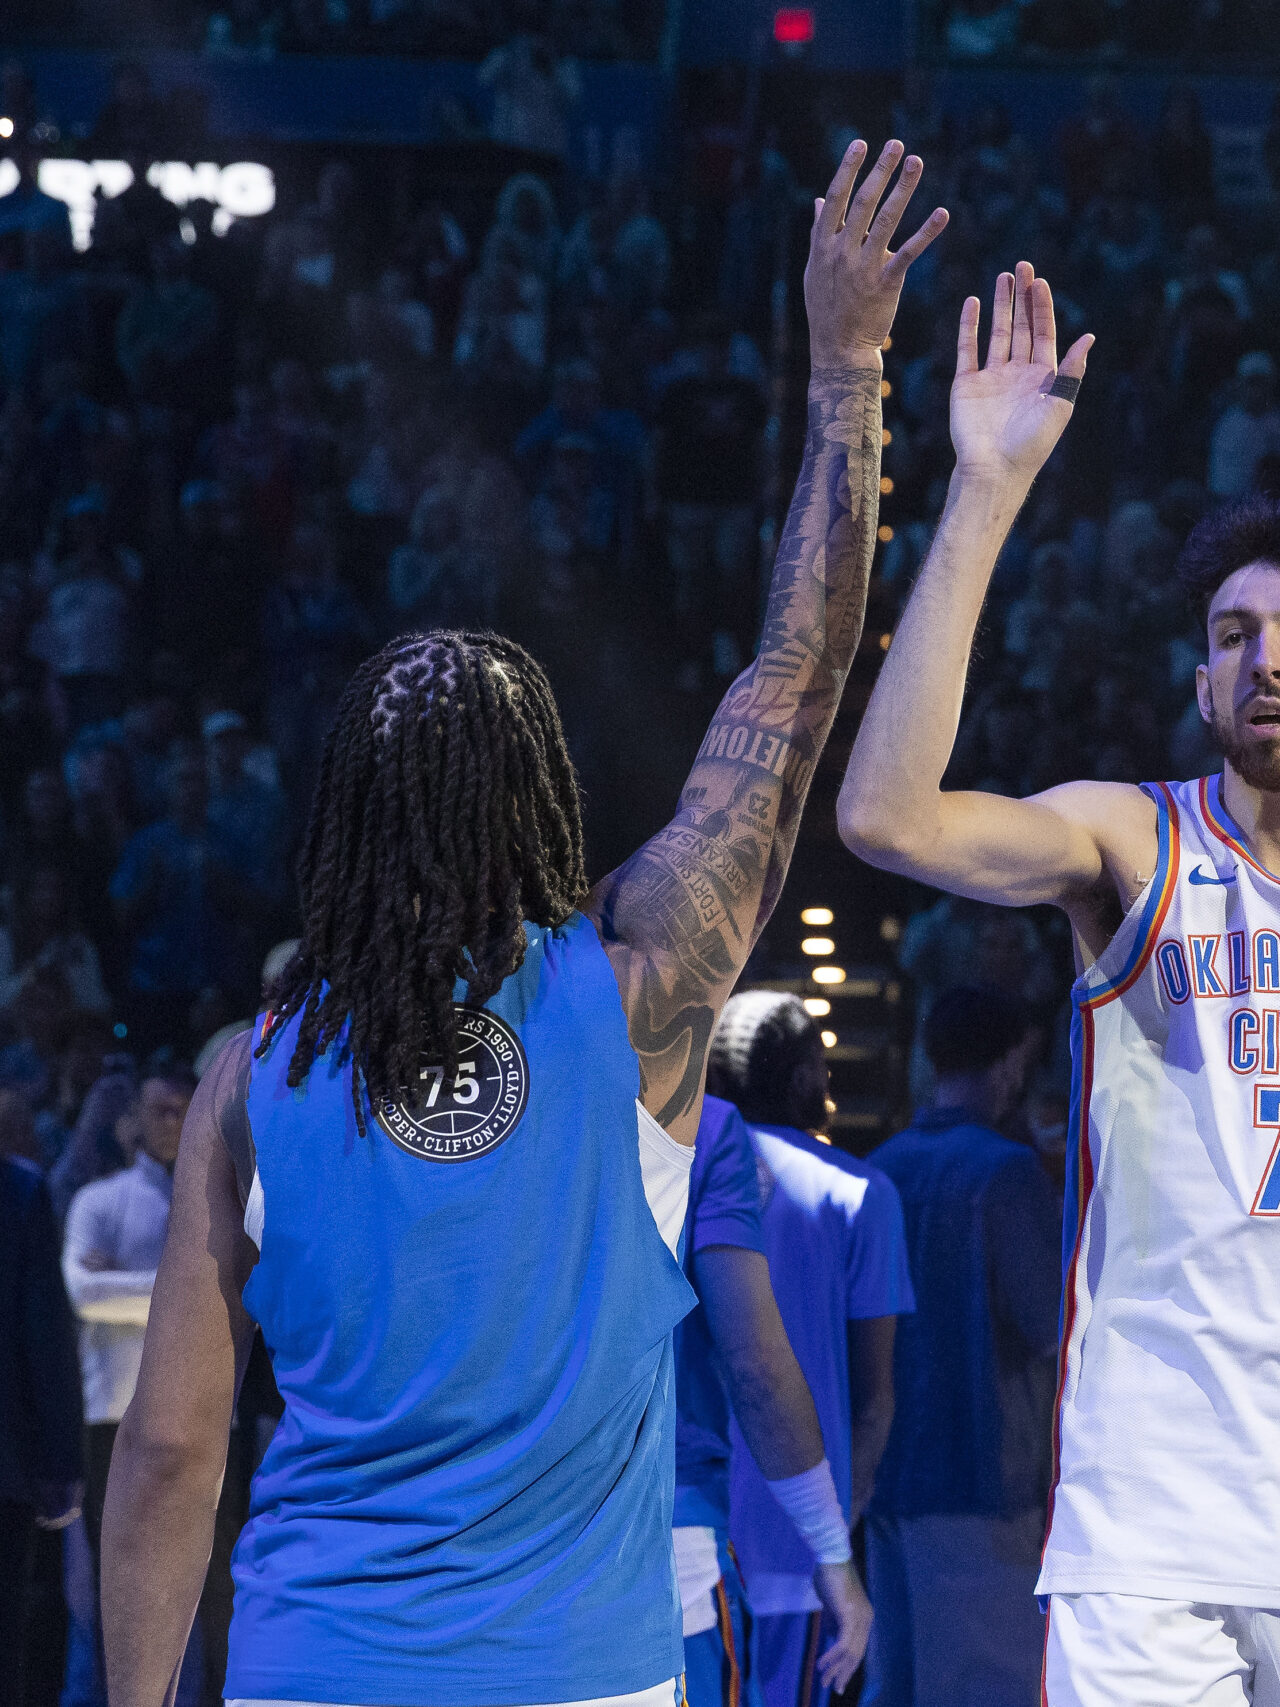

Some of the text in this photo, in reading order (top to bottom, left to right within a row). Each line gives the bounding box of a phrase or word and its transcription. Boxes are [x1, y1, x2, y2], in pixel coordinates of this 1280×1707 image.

[747, 792, 772, 819] 23
[689, 877, 721, 923] FORT
[484, 1027, 514, 1062] 1950
[419, 1061, 481, 1108] 75
[380, 1070, 520, 1153] OPER CLIFTON LLOYD
